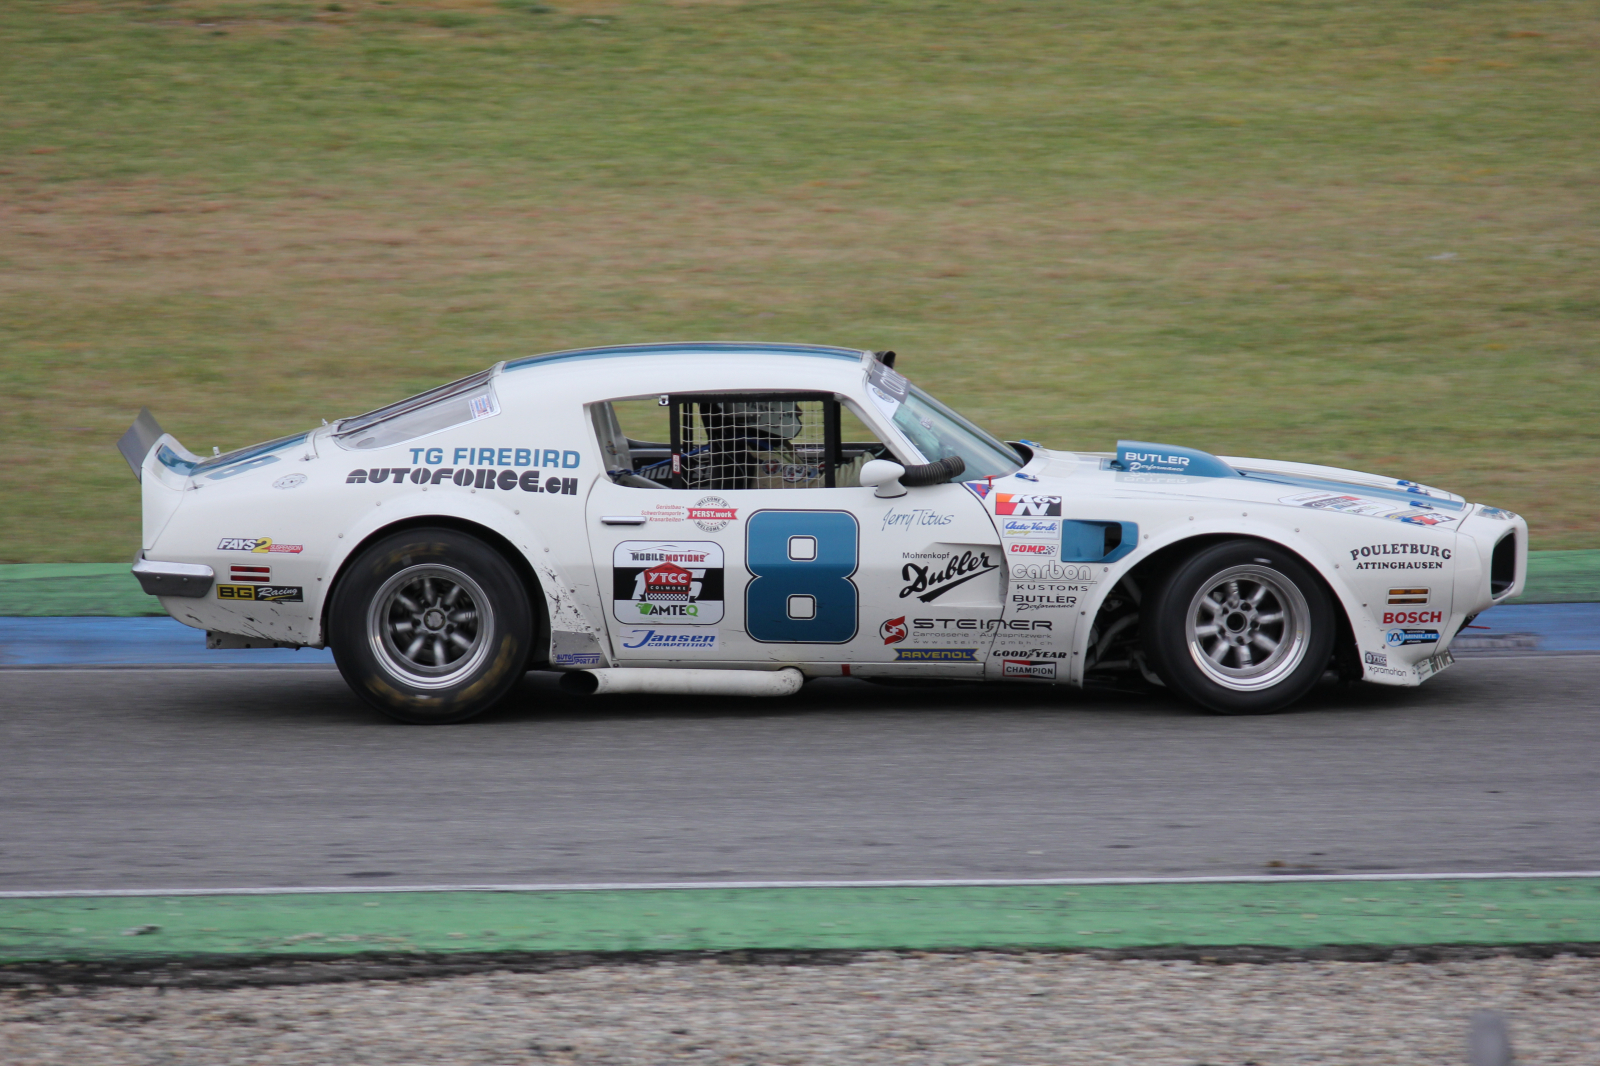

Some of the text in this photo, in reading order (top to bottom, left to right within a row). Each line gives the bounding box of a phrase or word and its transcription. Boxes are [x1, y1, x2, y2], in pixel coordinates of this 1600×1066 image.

[409, 447, 581, 469] TG FIREBIRD
[1124, 452, 1190, 466] BUTLER
[1129, 462, 1184, 472] Performance
[697, 496, 721, 507] WELCOME
[1008, 494, 1060, 516] K&N
[692, 510, 732, 518] PERSY.work
[881, 507, 954, 531] Jerry Titus
[696, 521, 720, 532] WELCOME
[1005, 521, 1031, 530] Auto
[218, 537, 273, 553] FAYS2
[1011, 544, 1046, 553] COMP
[902, 552, 950, 560] Mohrenkopf
[1350, 543, 1452, 561] POULETBURG
[1012, 560, 1091, 580] carbon
[1356, 561, 1443, 570] ATTINGHAUSEN
[648, 572, 688, 583] YTCC
[744, 508, 860, 645] 8
[899, 550, 999, 603] Dubler
[257, 587, 298, 598] Racing
[1012, 595, 1077, 604] BUTLER
[649, 604, 698, 617] AMTEQ
[1016, 603, 1074, 613] Performance
[1383, 611, 1442, 624] BOSCH
[913, 618, 1052, 631] STEINER
[623, 630, 716, 648] Jansen
[901, 651, 971, 659] RAVENOL
[1006, 666, 1053, 675] CHAMPION
[1368, 665, 1407, 677] x-promotion
